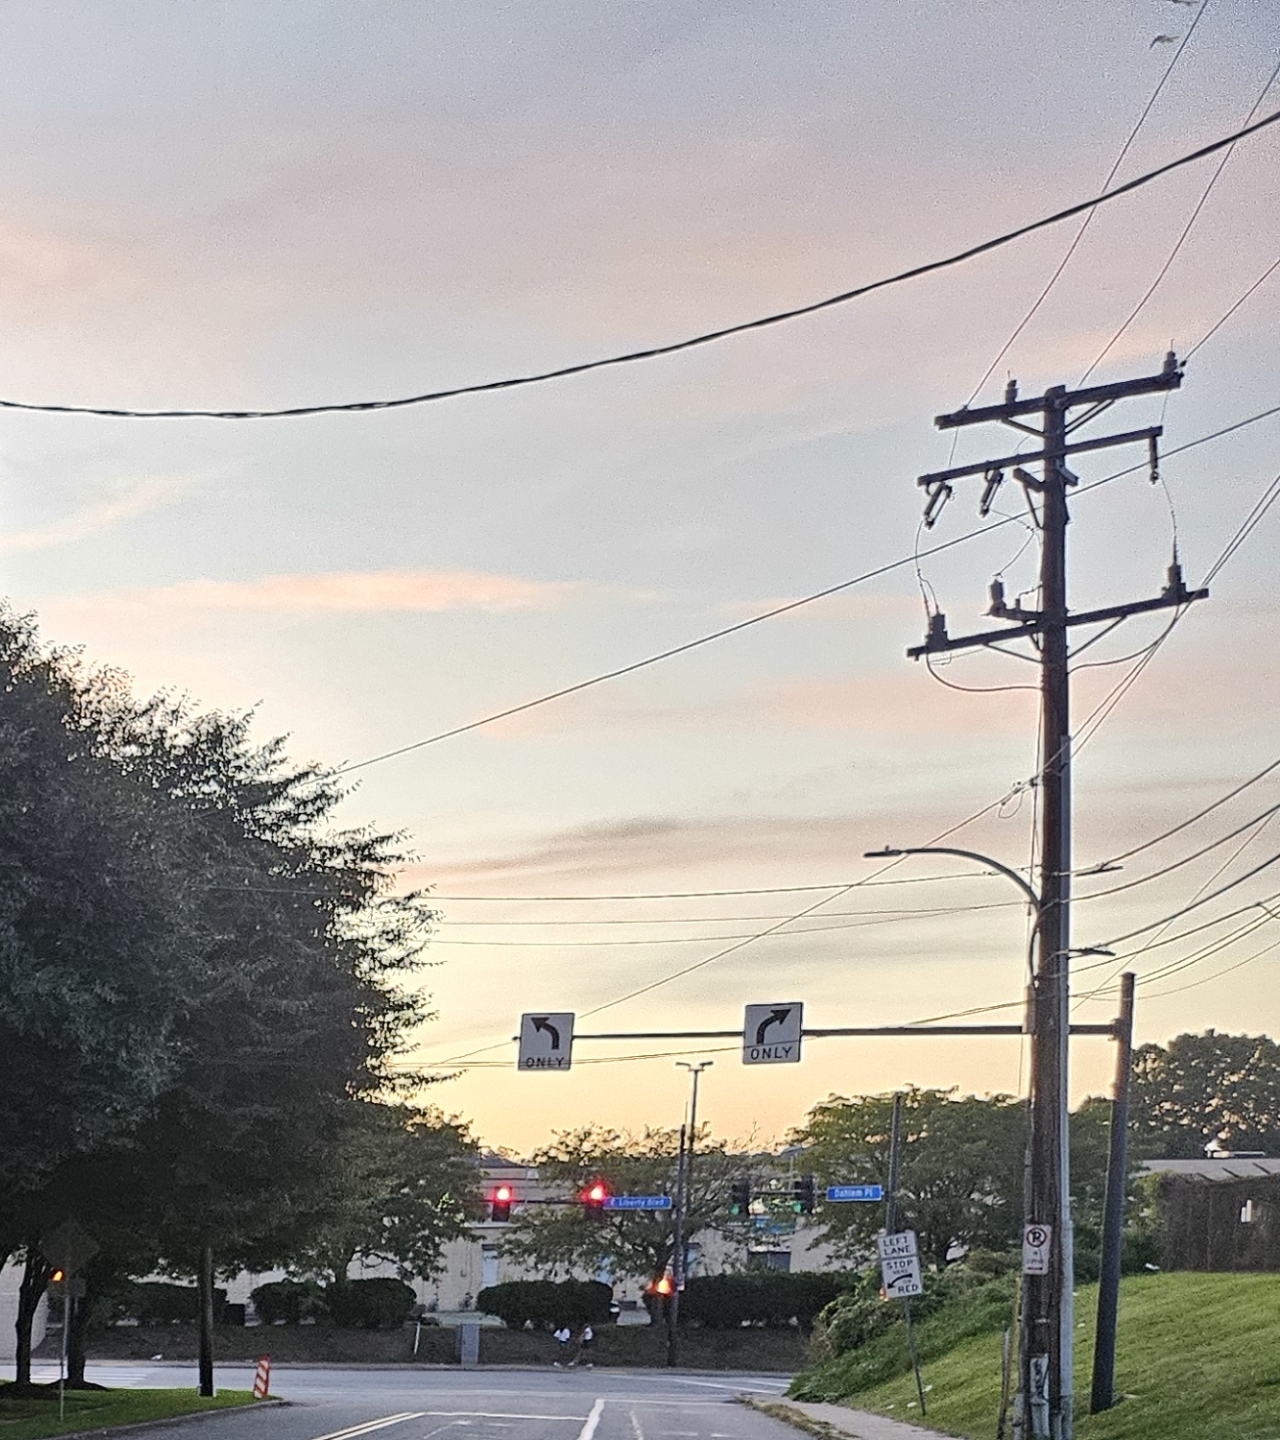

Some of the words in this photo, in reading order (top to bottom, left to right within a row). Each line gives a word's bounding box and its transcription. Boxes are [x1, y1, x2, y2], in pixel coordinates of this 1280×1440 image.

[750, 1046, 792, 1060] ONLY
[525, 1056, 565, 1068] ONLY
[883, 1235, 908, 1247] LEFT
[883, 1244, 911, 1256] LANE
[886, 1259, 914, 1269] STOP
[897, 1283, 919, 1294] RED
